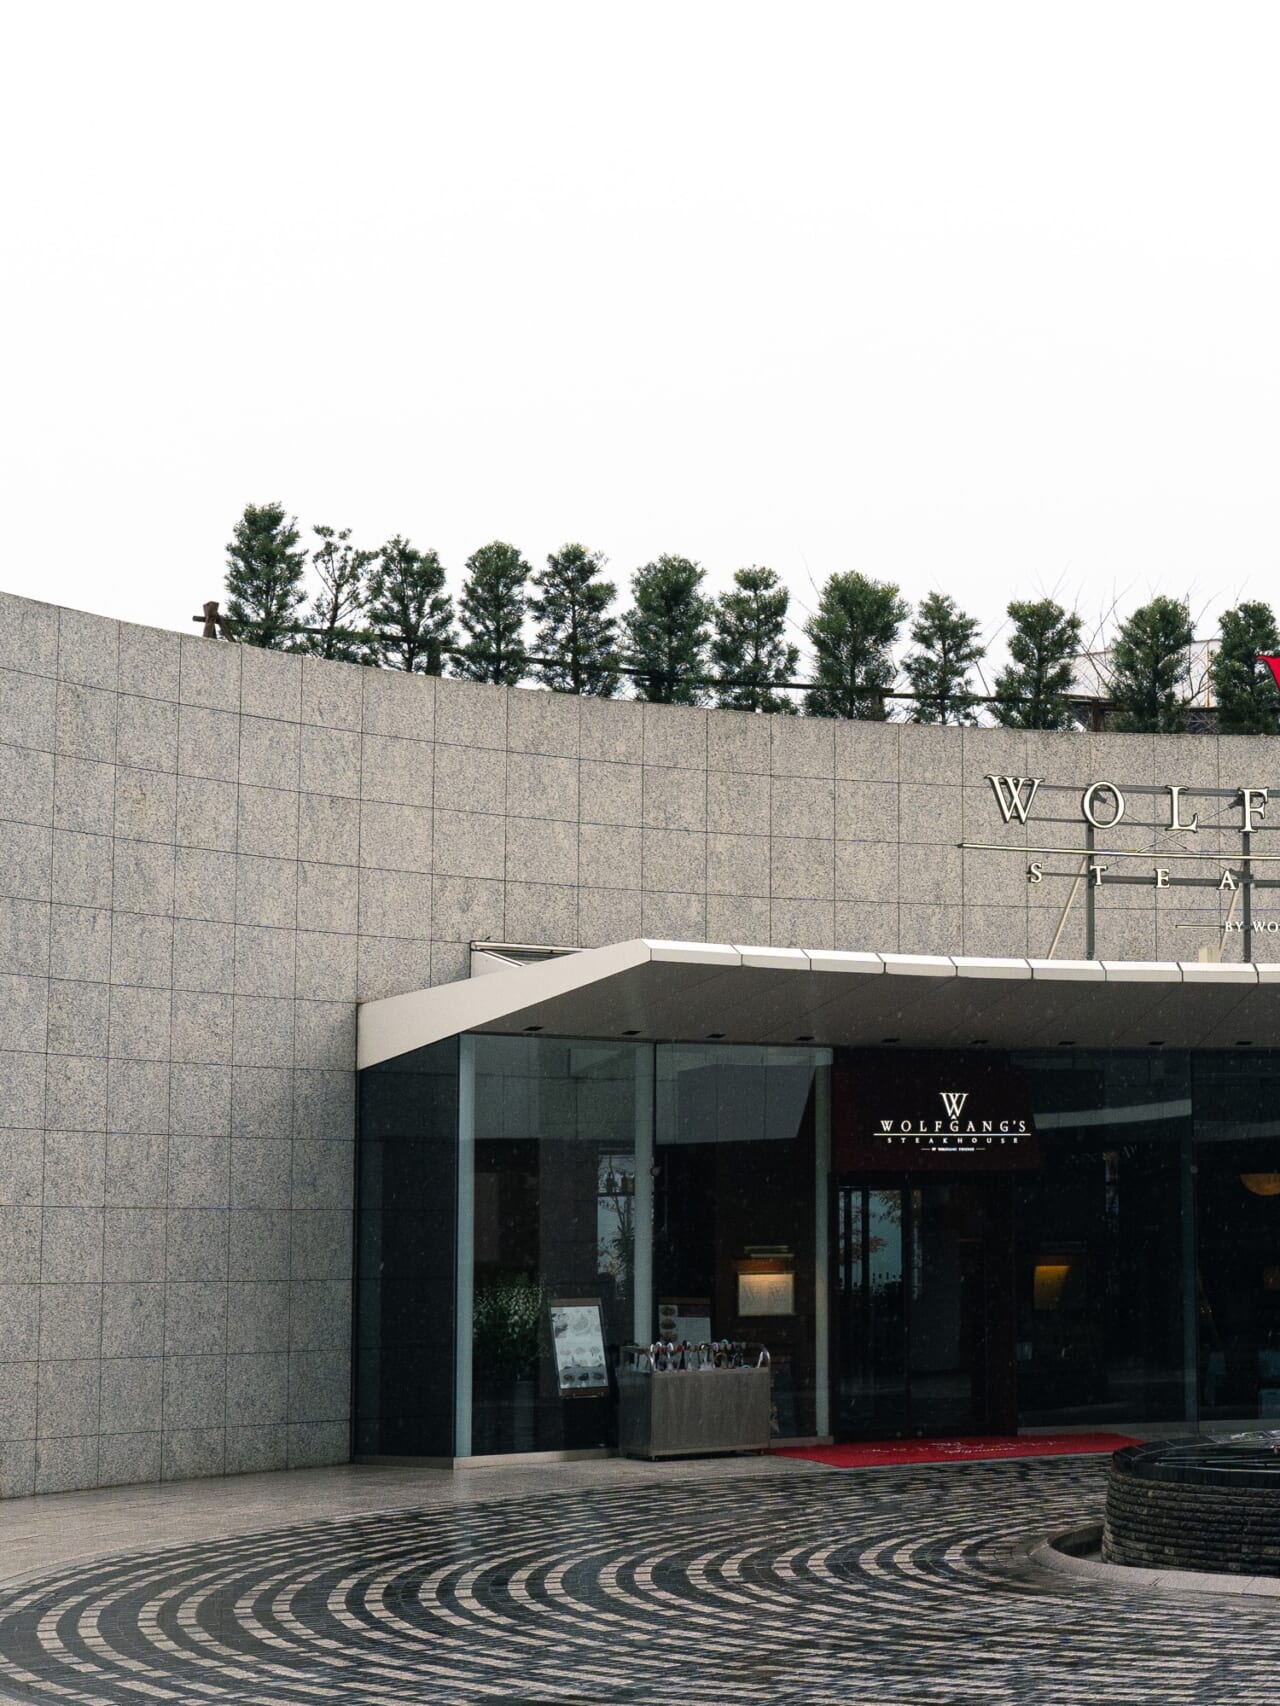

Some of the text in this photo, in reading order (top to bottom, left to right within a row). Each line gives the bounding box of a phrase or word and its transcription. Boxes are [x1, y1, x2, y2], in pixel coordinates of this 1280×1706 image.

[1224, 920, 1244, 933] BY
[939, 1092, 970, 1117] W
[880, 1120, 1026, 1132] WOLFGANG'S
